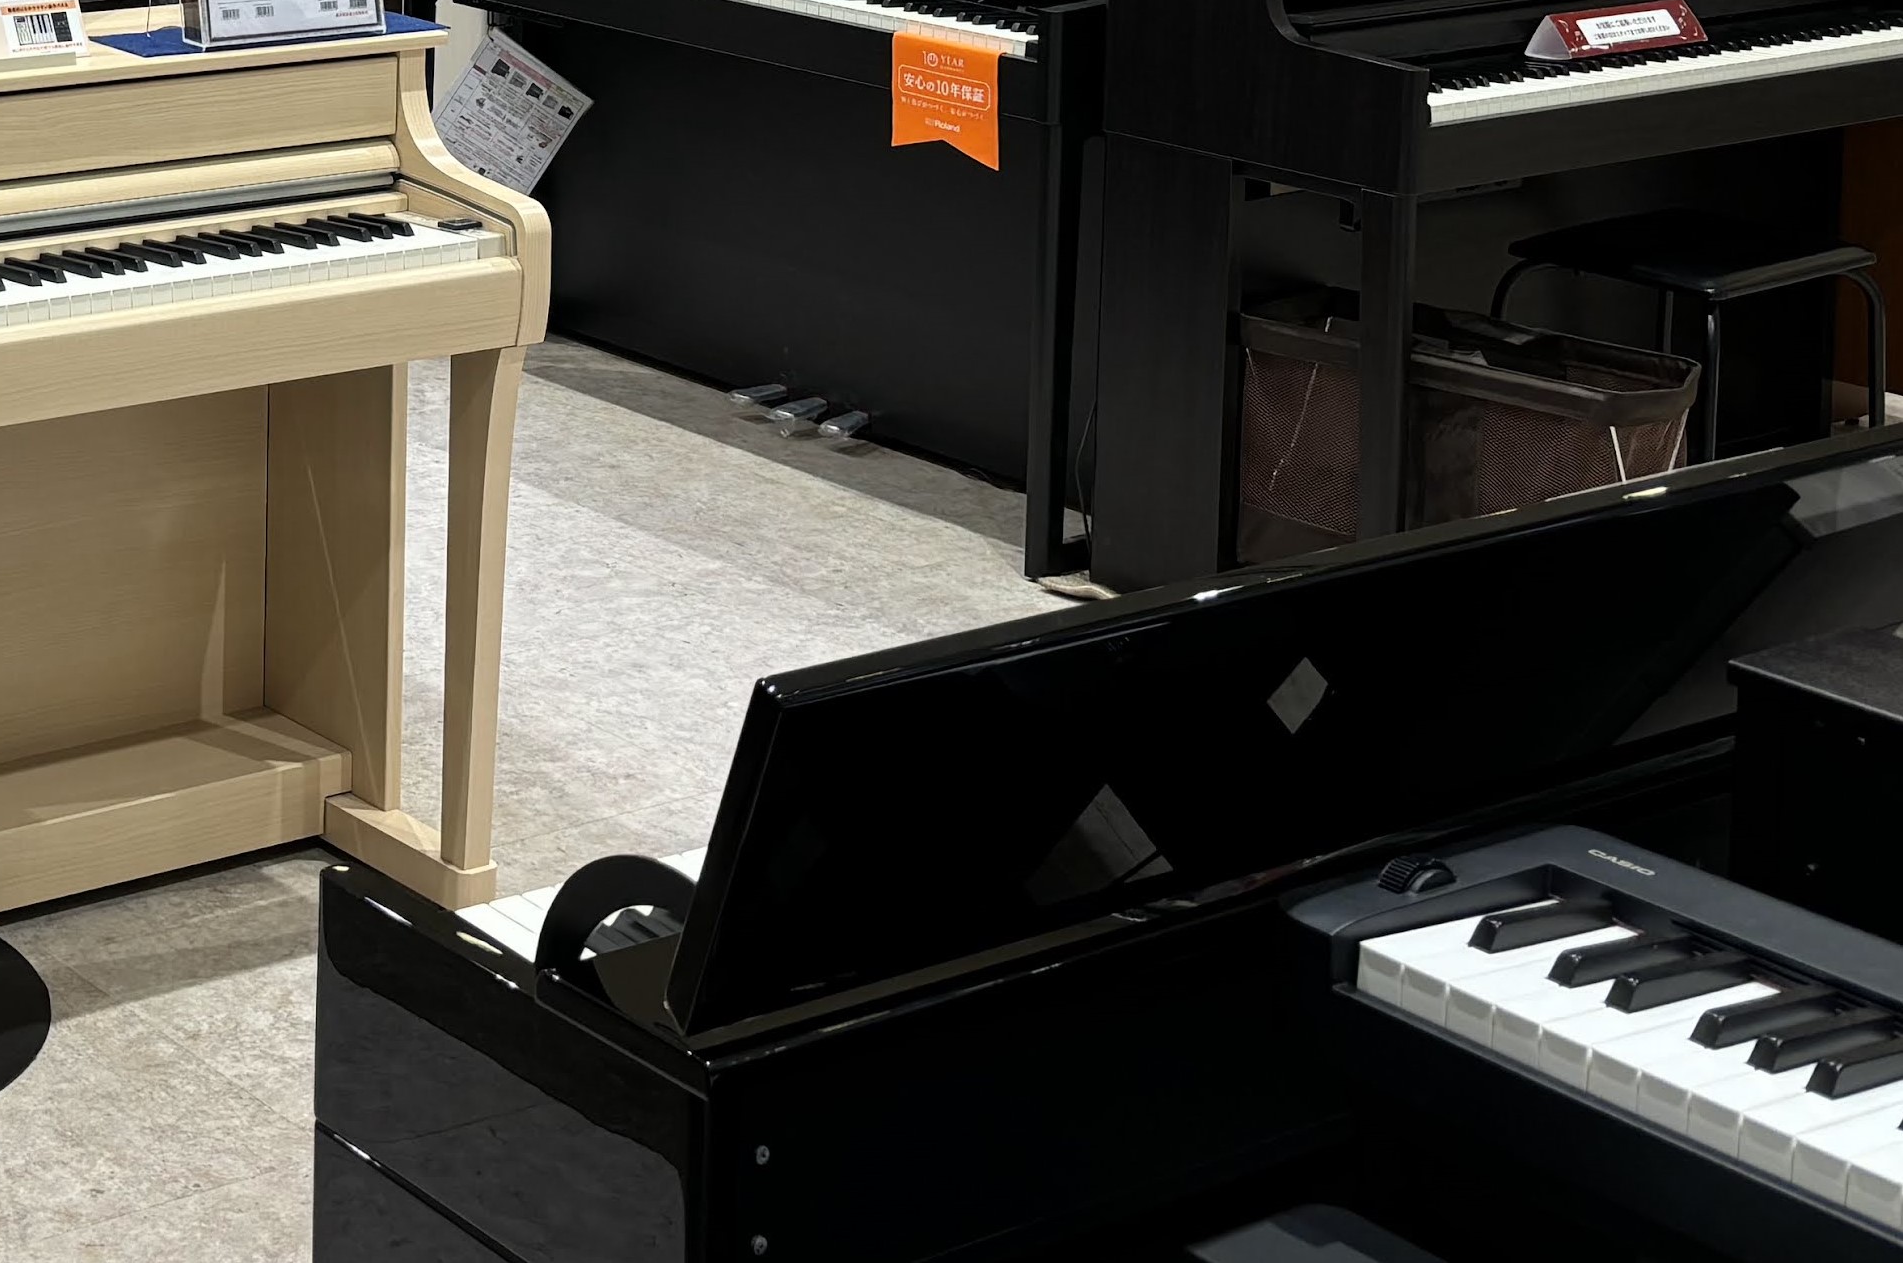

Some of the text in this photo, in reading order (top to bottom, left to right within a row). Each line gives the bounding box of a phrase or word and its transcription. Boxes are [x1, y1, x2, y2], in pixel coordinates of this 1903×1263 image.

[922, 50, 965, 68] 10 YEAR
[903, 73, 985, 103] 安心の10年保証
[934, 119, 961, 133] Roland
[1587, 847, 1656, 877] CASIO
